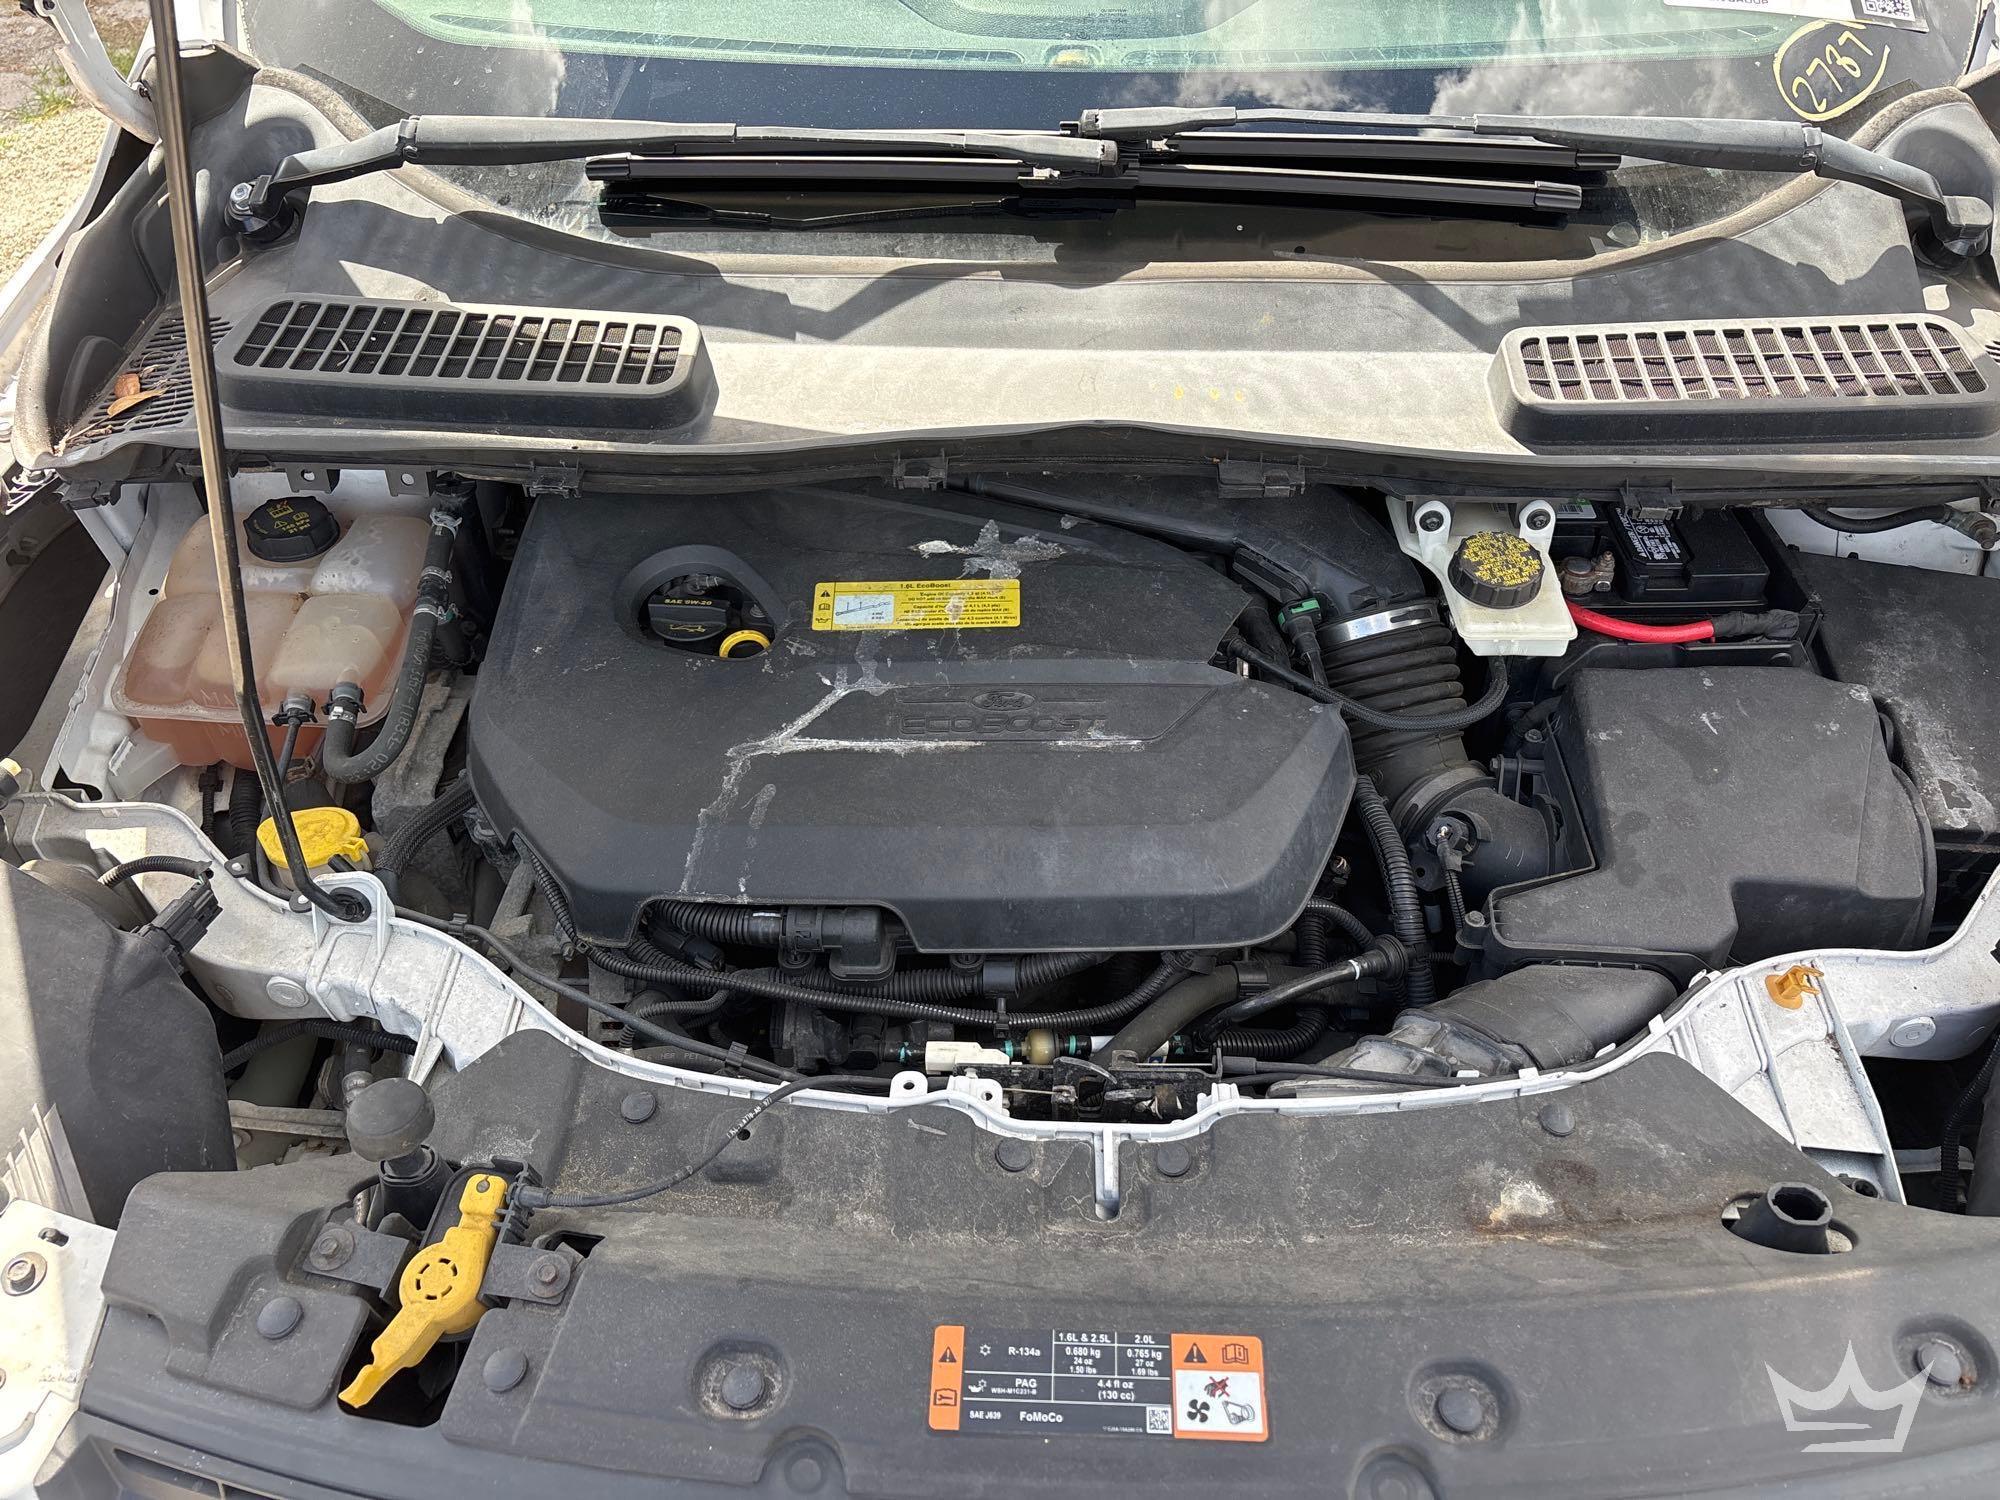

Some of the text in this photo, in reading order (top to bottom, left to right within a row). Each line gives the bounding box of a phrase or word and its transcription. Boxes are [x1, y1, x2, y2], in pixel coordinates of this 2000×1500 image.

[1058, 1332, 1111, 1343] 1.6L & 2.5L
[1134, 1334, 1155, 1344] 2.0L
[1008, 1346, 1041, 1357] R-134a
[1065, 1346, 1101, 1359] 0.680 kg
[1126, 1348, 1162, 1360] 0.765 kg
[1073, 1357, 1083, 1365] 24
[1135, 1359, 1144, 1367] 27
[1069, 1366, 1097, 1374] 1.50 lbs
[1147, 1368, 1159, 1376] lbs
[1015, 1378, 1038, 1388] PAG
[1097, 1379, 1135, 1389] 4.4 fl oz
[1098, 1390, 1135, 1402] (130 cc)
[969, 1410, 984, 1419] SAE
[1019, 1411, 1063, 1423] FoMoCo
